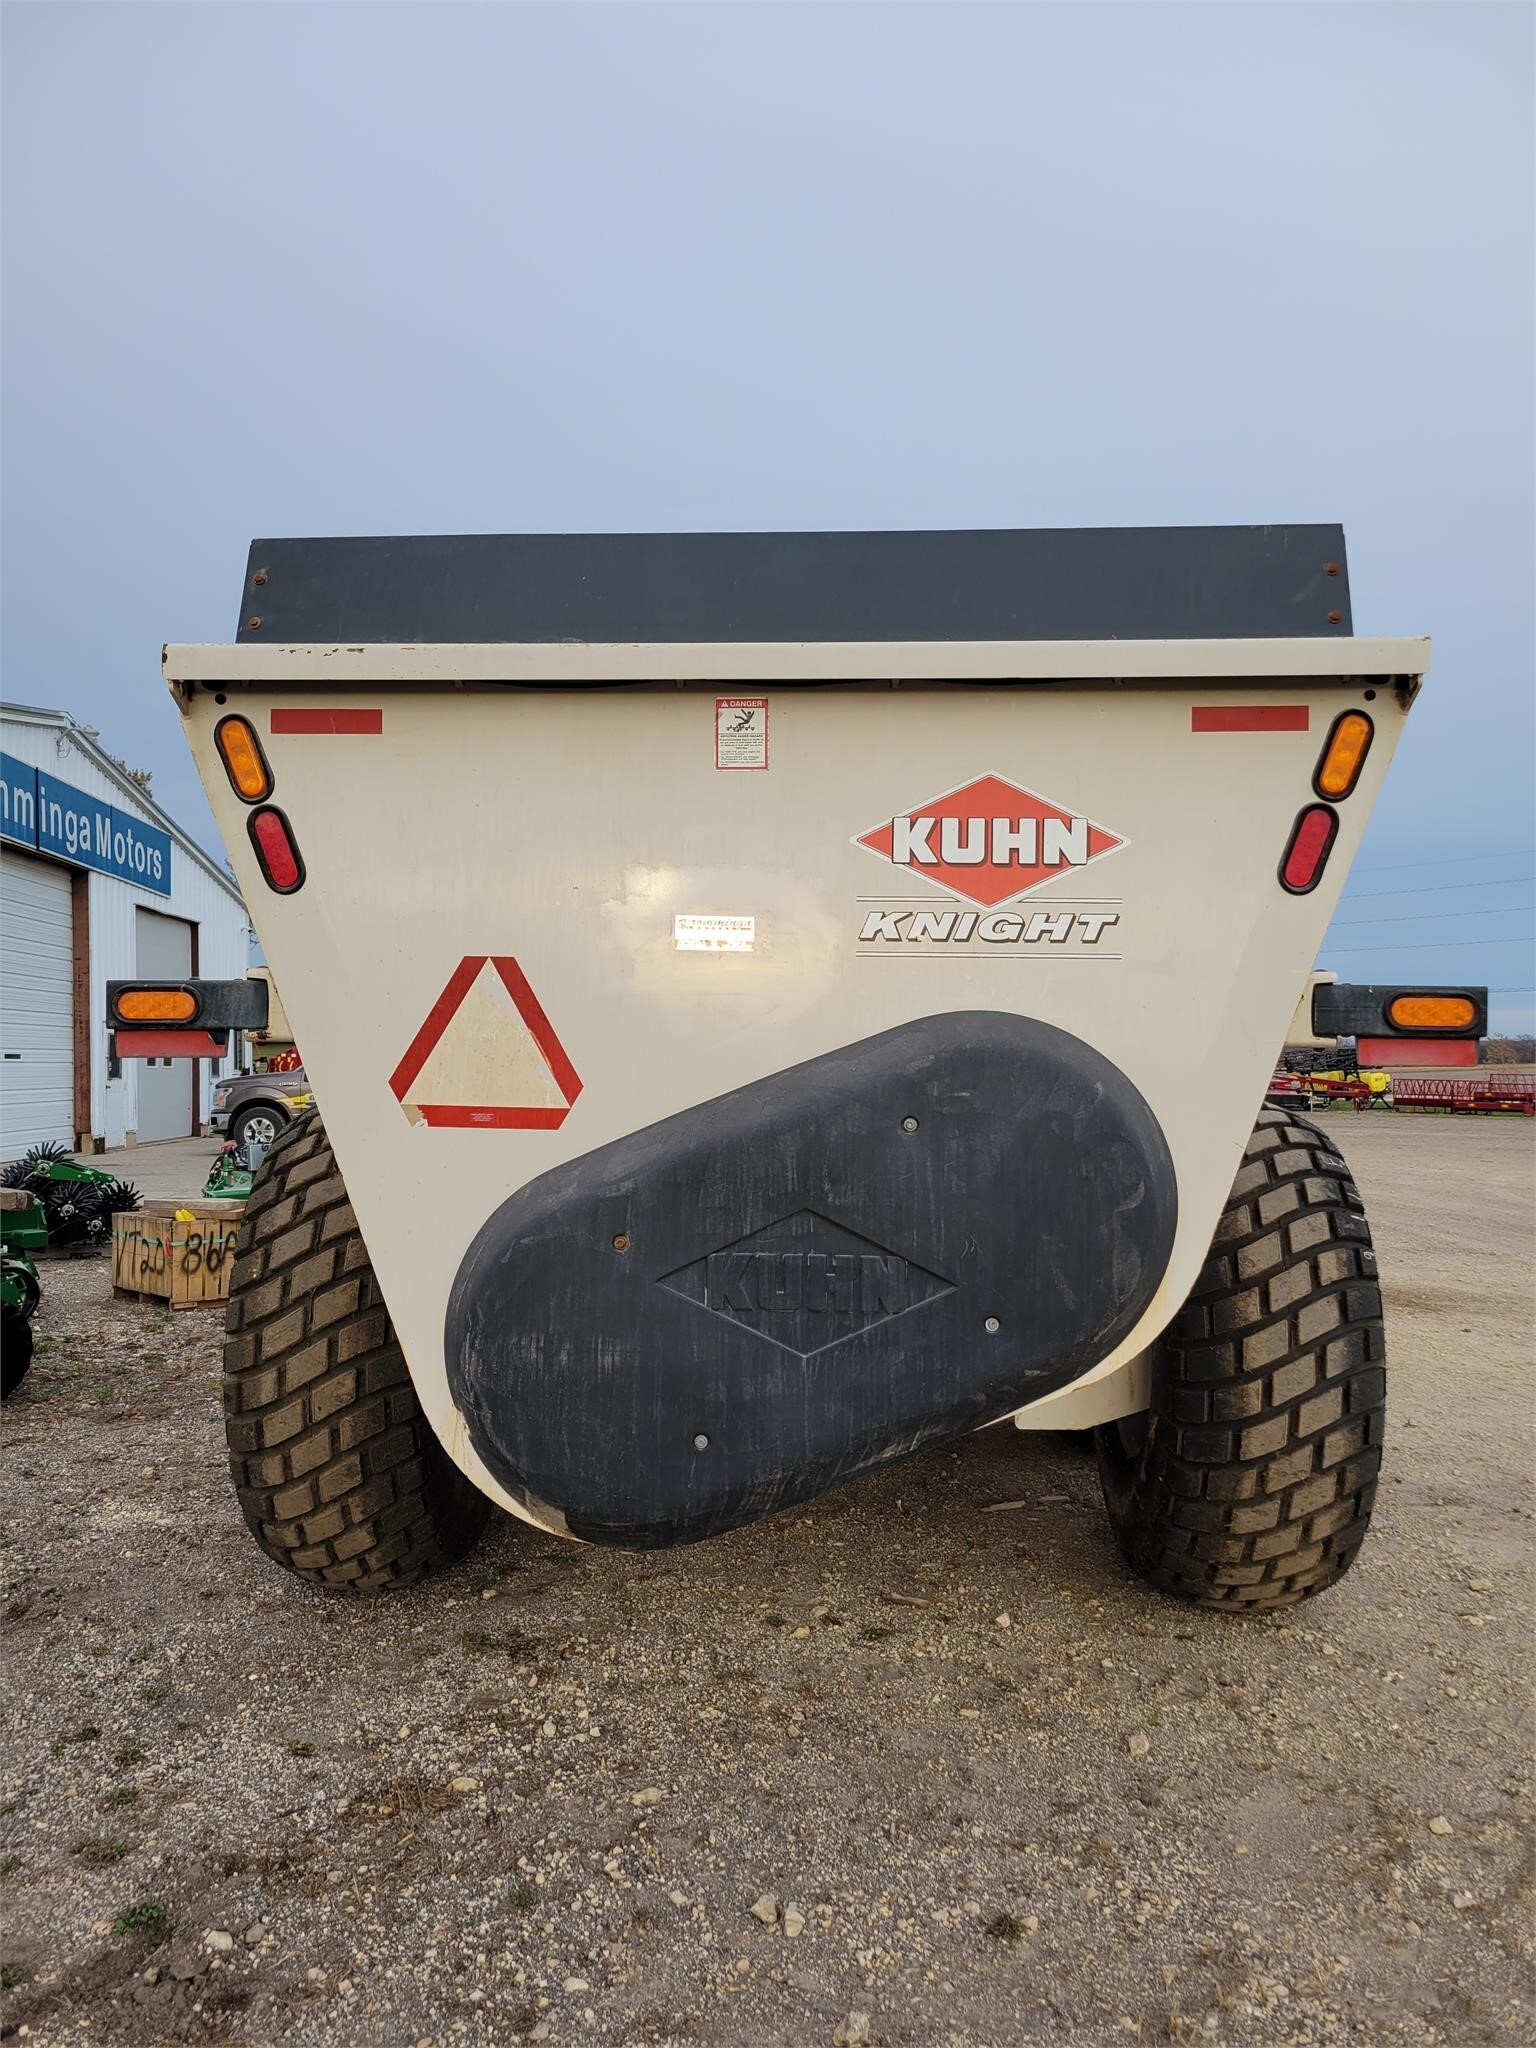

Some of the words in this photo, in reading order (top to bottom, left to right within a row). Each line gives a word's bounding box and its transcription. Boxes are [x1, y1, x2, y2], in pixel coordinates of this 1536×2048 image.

[729, 700, 763, 708] DANGER
[95, 813, 163, 881] Motors
[891, 817, 1090, 867] KUHN
[858, 911, 1121, 944] KNIGHT
[704, 1252, 909, 1314] KUHN
